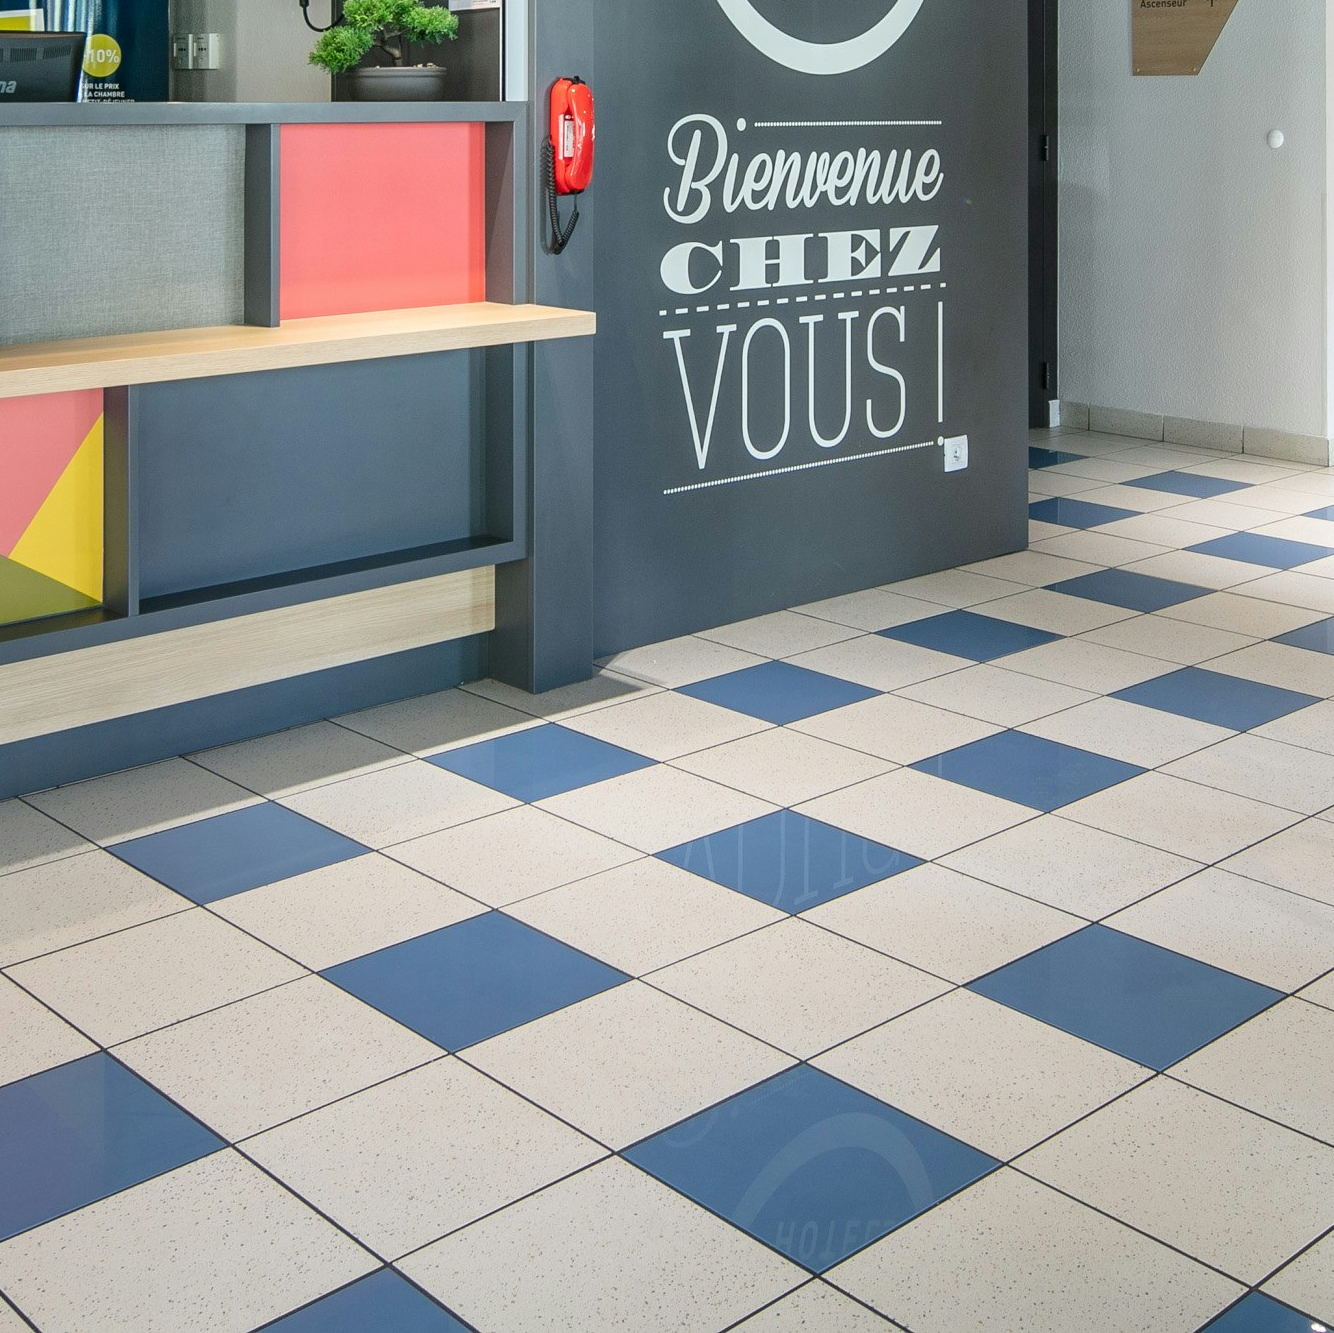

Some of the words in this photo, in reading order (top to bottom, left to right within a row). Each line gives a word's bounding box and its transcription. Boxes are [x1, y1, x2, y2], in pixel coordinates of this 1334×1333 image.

[1140, 0, 1187, 8] Ascenseur
[663, 113, 944, 224] Bienvenue
[660, 224, 941, 295] CHEZ
[663, 305, 906, 469] VOUS
